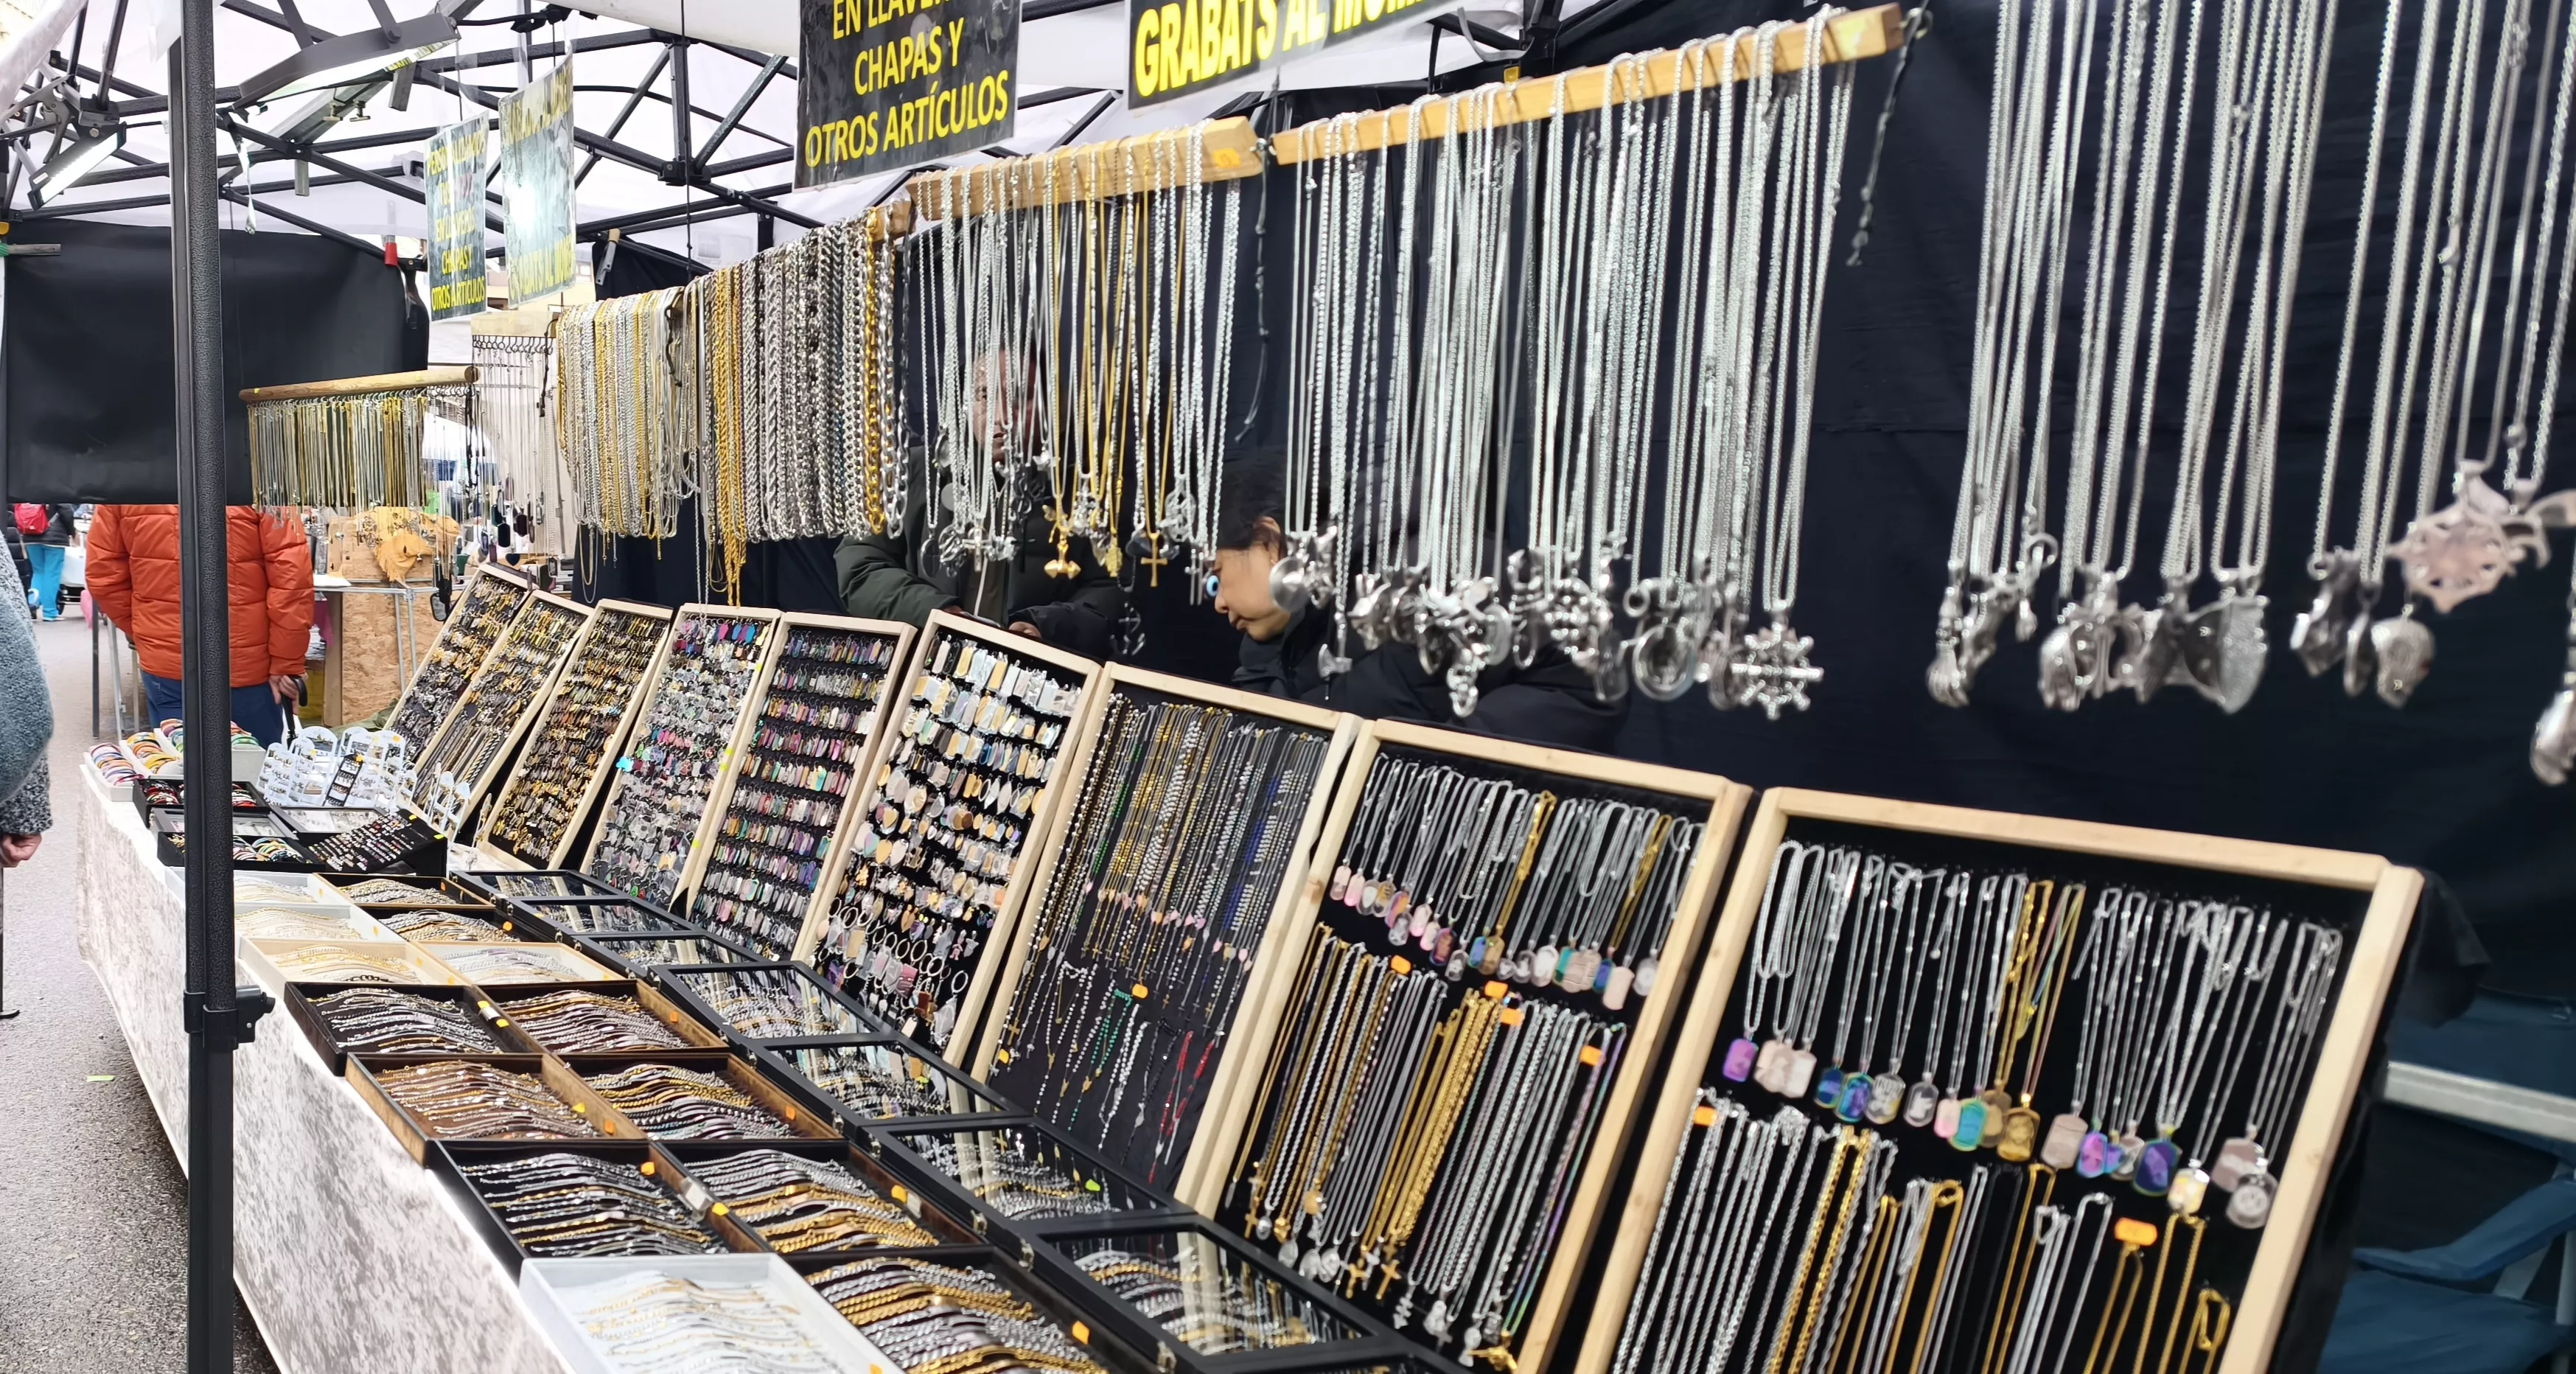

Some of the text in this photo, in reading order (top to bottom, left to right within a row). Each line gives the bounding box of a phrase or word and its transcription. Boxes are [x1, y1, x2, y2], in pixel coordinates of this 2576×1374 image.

[834, 0, 861, 40] EN
[1134, 0, 1278, 98] GRABATS
[854, 17, 964, 95] CHAPAS Y
[805, 70, 1008, 168] OTROS ARTÍCULOS
[441, 248, 467, 275] CHAPAS
[431, 273, 485, 311] OTROS ARTÍCULOS
